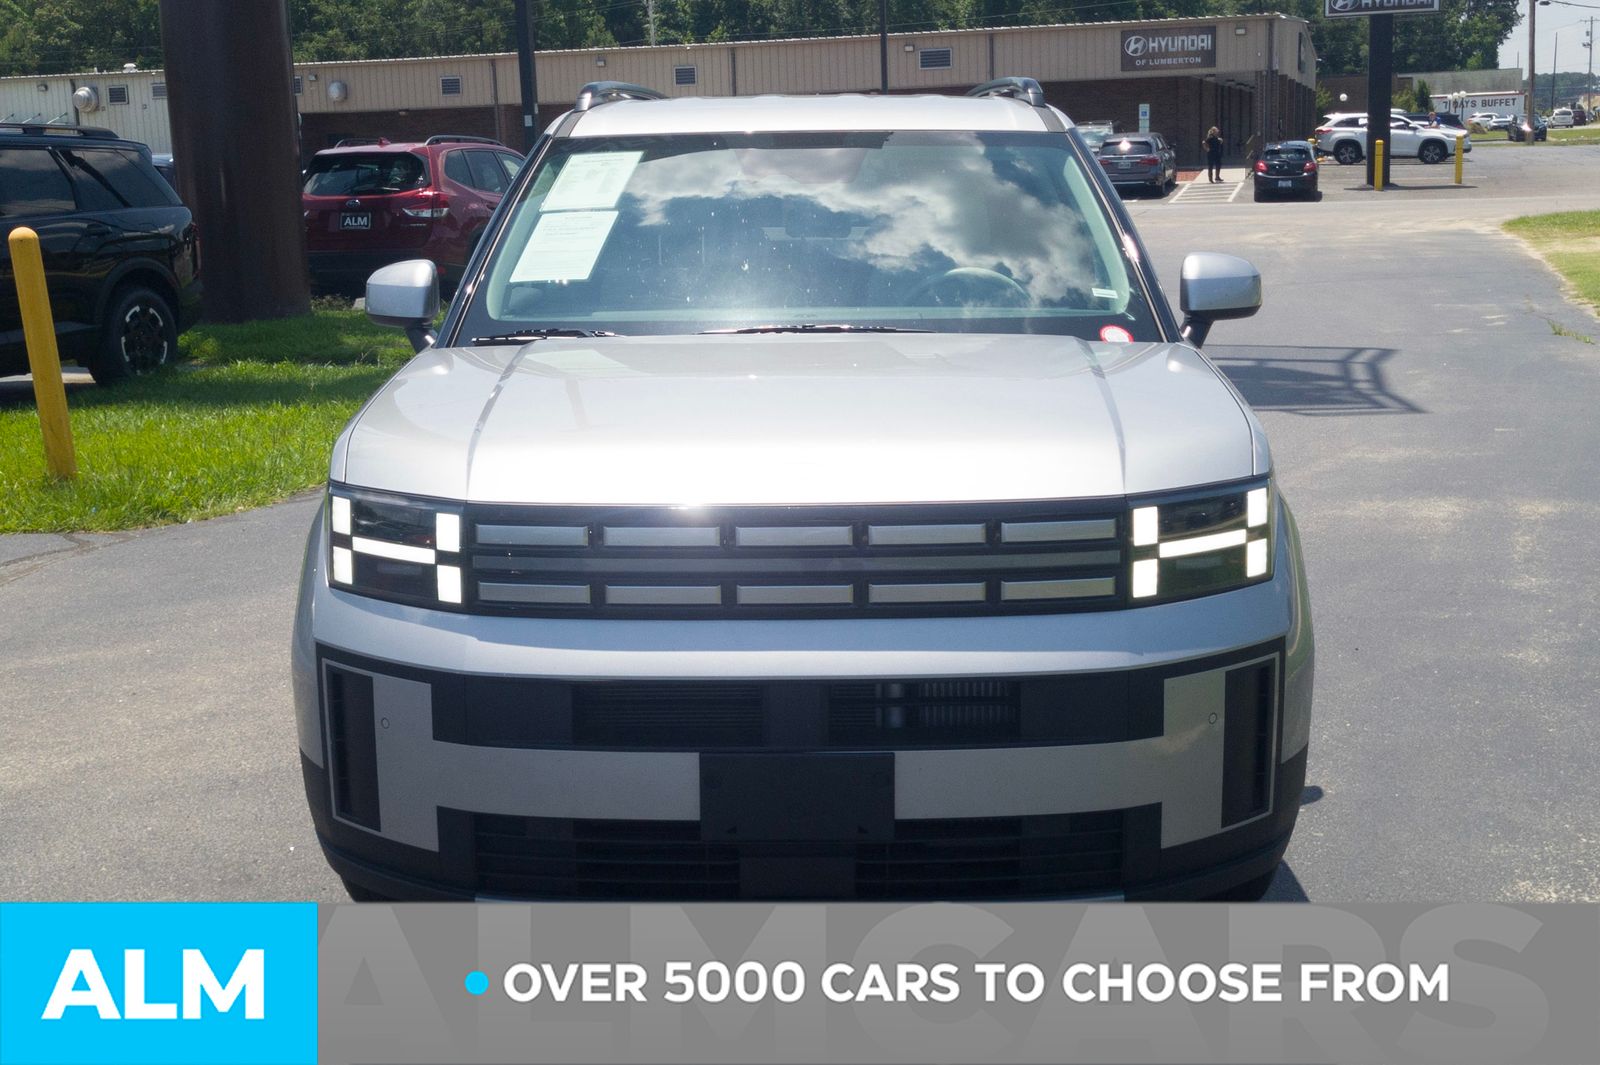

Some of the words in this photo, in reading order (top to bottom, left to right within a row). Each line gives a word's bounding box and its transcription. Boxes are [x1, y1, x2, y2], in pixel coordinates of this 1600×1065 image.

[1149, 34, 1212, 53] HYUNDAI
[1149, 56, 1201, 65] LUMBERTON
[1443, 101, 1448, 109] 7
[1453, 99, 1477, 109] DAYS
[1481, 98, 1517, 108] BUFFET
[344, 216, 368, 226] ALM
